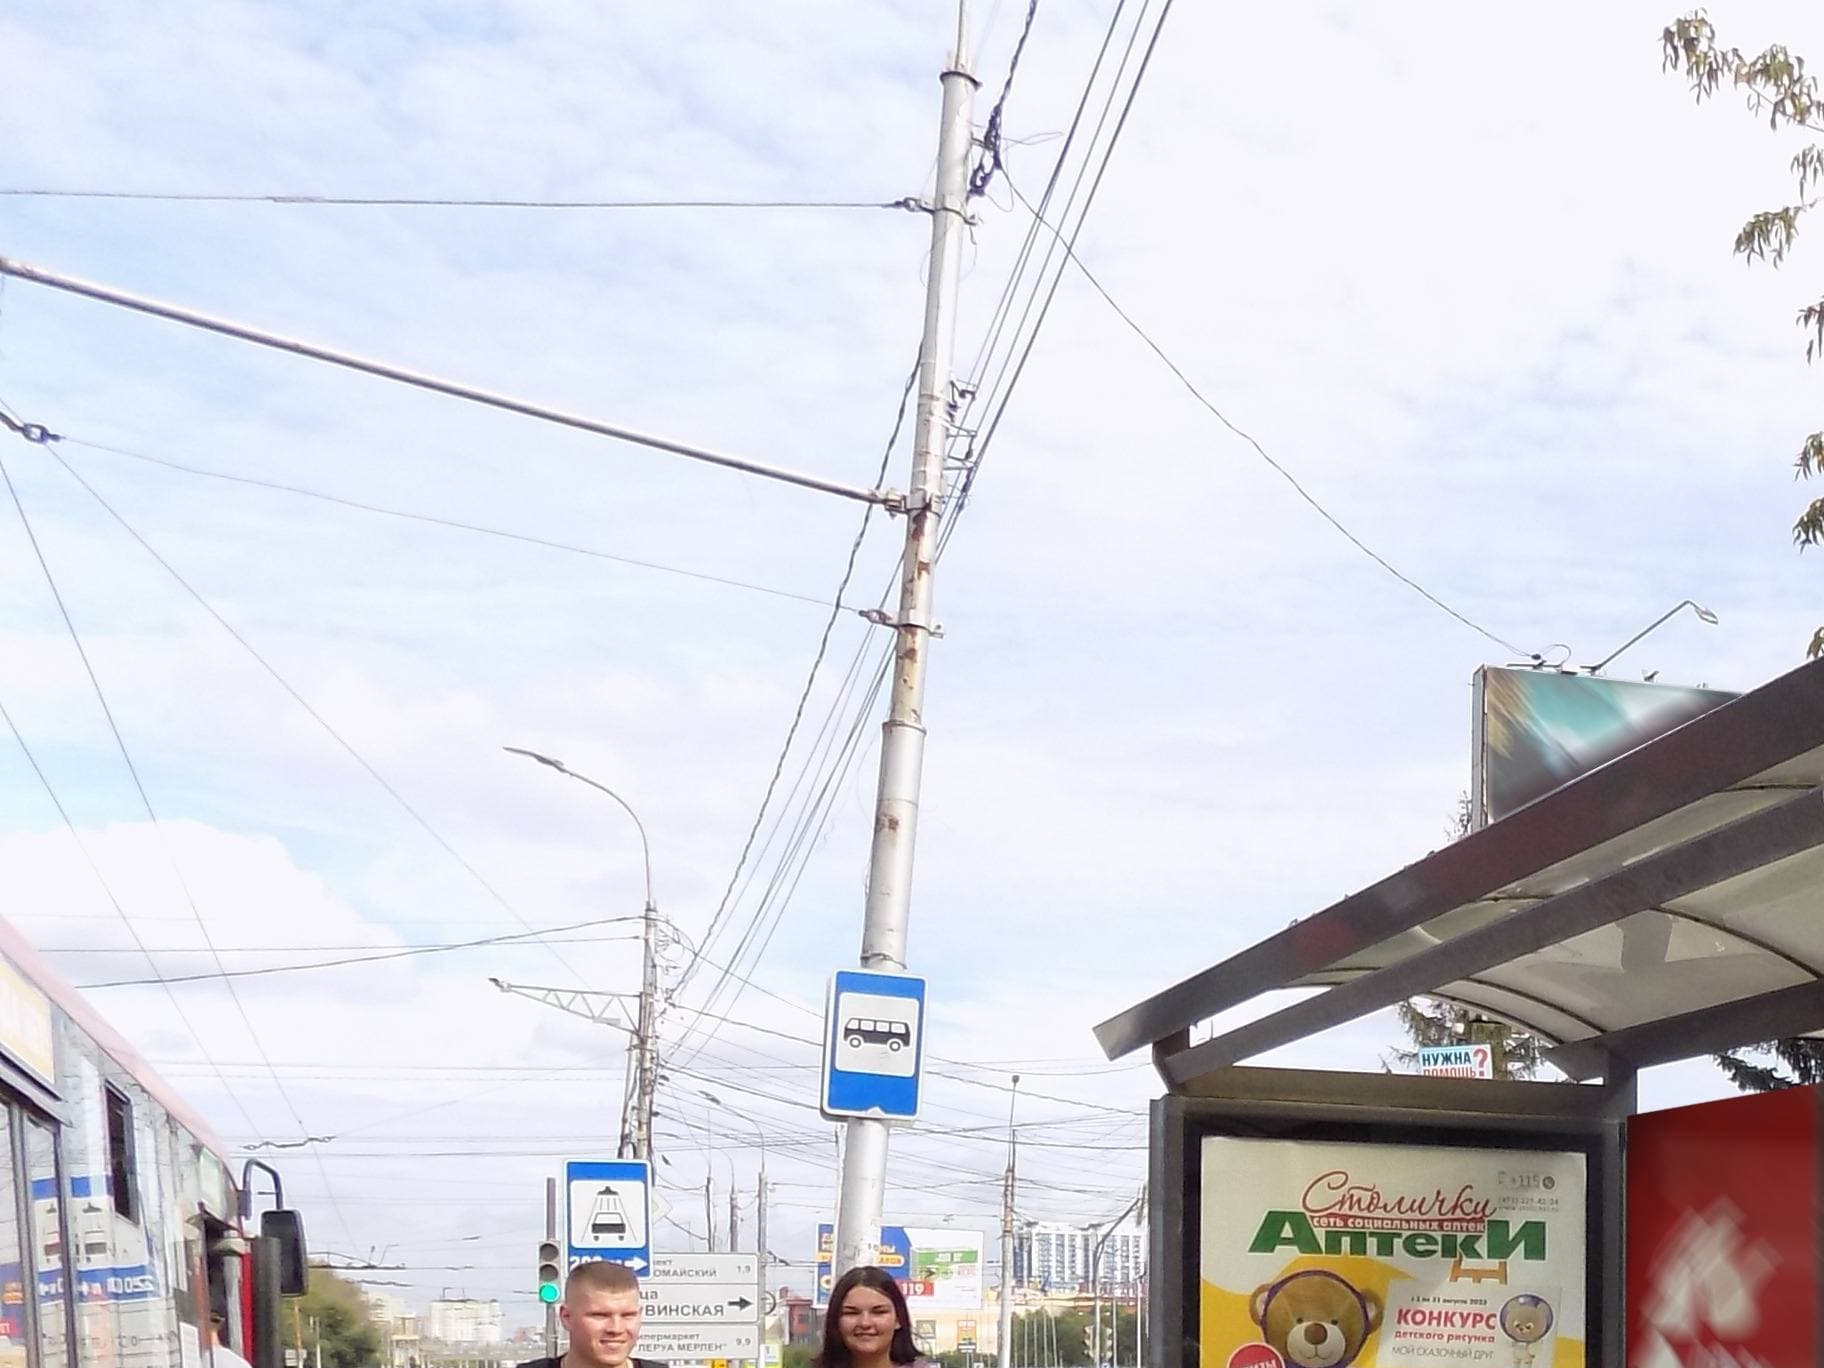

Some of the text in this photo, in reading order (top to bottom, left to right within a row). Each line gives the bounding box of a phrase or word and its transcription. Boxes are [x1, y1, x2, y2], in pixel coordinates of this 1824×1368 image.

[1422, 1052, 1472, 1066] НУЖНА
[1302, 1171, 1498, 1216] Столички
[1313, 1216, 1486, 1232] сеть социальных аптек
[642, 1305, 725, 1317] ВИНСКАЯ
[1397, 1308, 1497, 1330] КОНКУРС
[1394, 1330, 1496, 1345] детского рисунка
